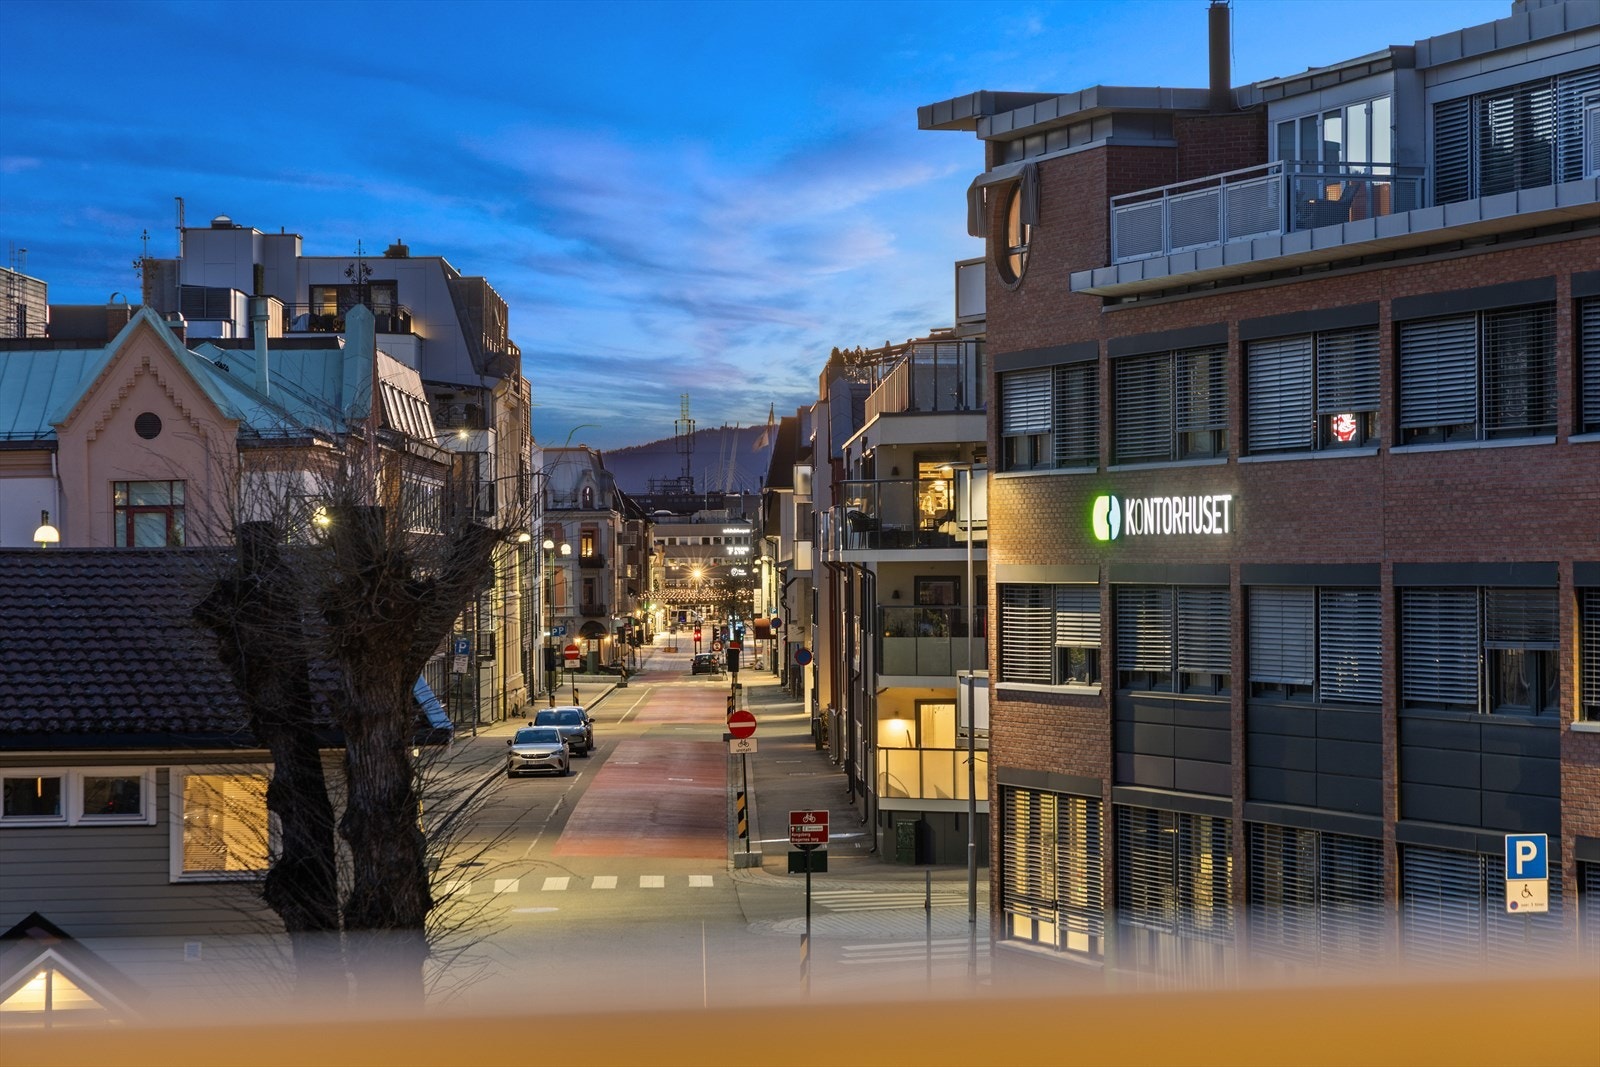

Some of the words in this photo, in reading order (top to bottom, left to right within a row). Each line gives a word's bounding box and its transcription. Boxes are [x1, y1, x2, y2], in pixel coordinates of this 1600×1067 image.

[1125, 494, 1232, 535] KONTORHUSET
[458, 641, 467, 653] P
[1516, 840, 1537, 874] P
